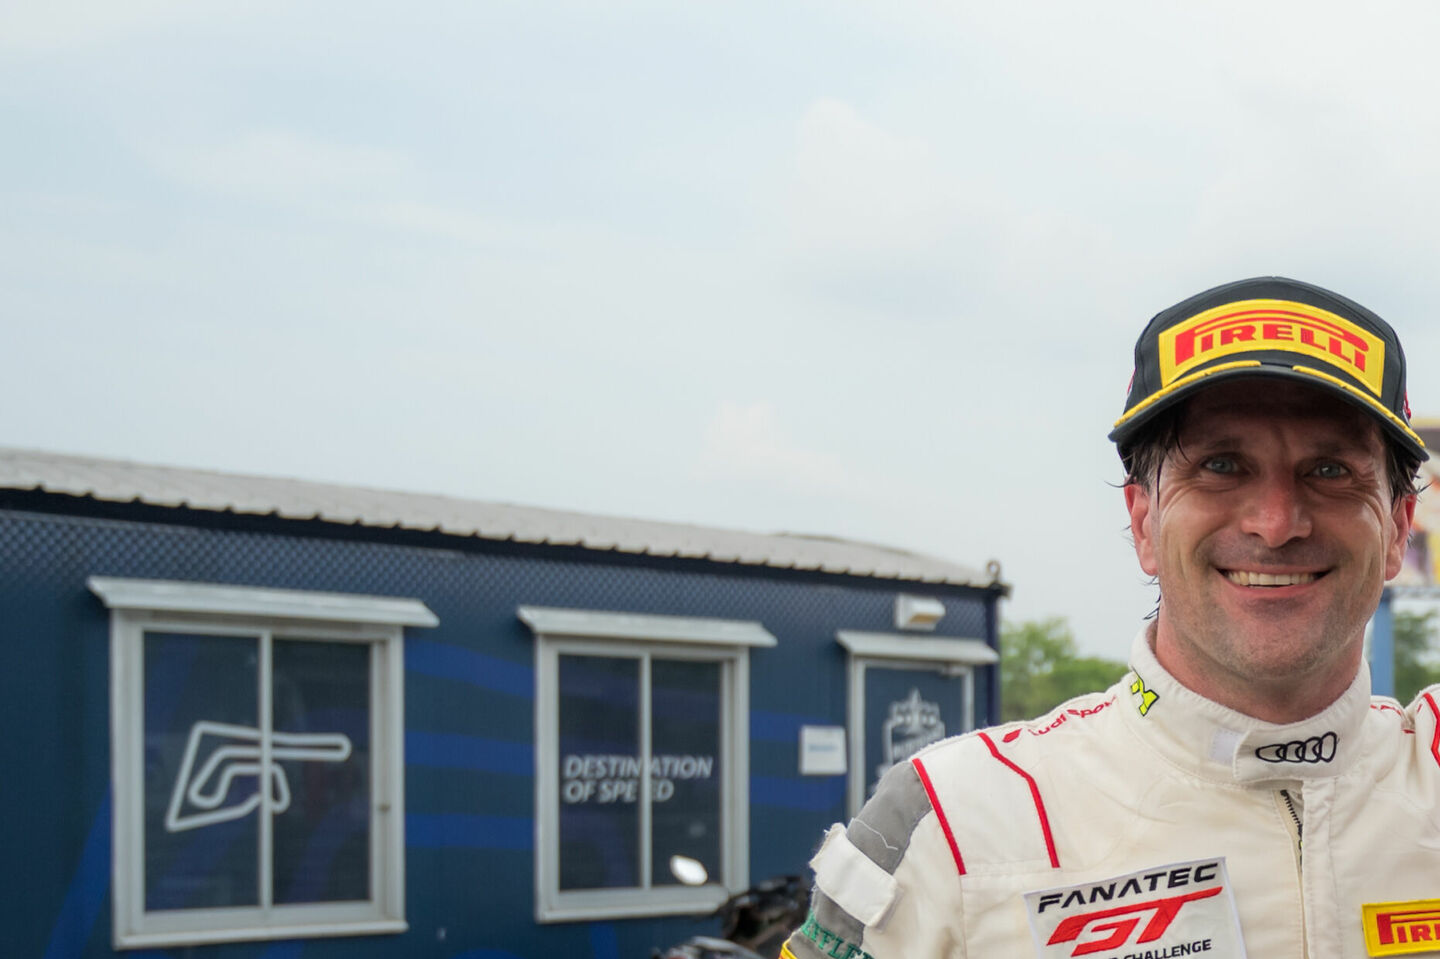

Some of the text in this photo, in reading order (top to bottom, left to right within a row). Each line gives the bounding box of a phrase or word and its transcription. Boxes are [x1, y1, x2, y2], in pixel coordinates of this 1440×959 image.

[1175, 310, 1369, 372] PIRELLI
[564, 778, 675, 803] OF SPED
[1038, 862, 1218, 913] FANATEC
[1046, 886, 1223, 958] GT
